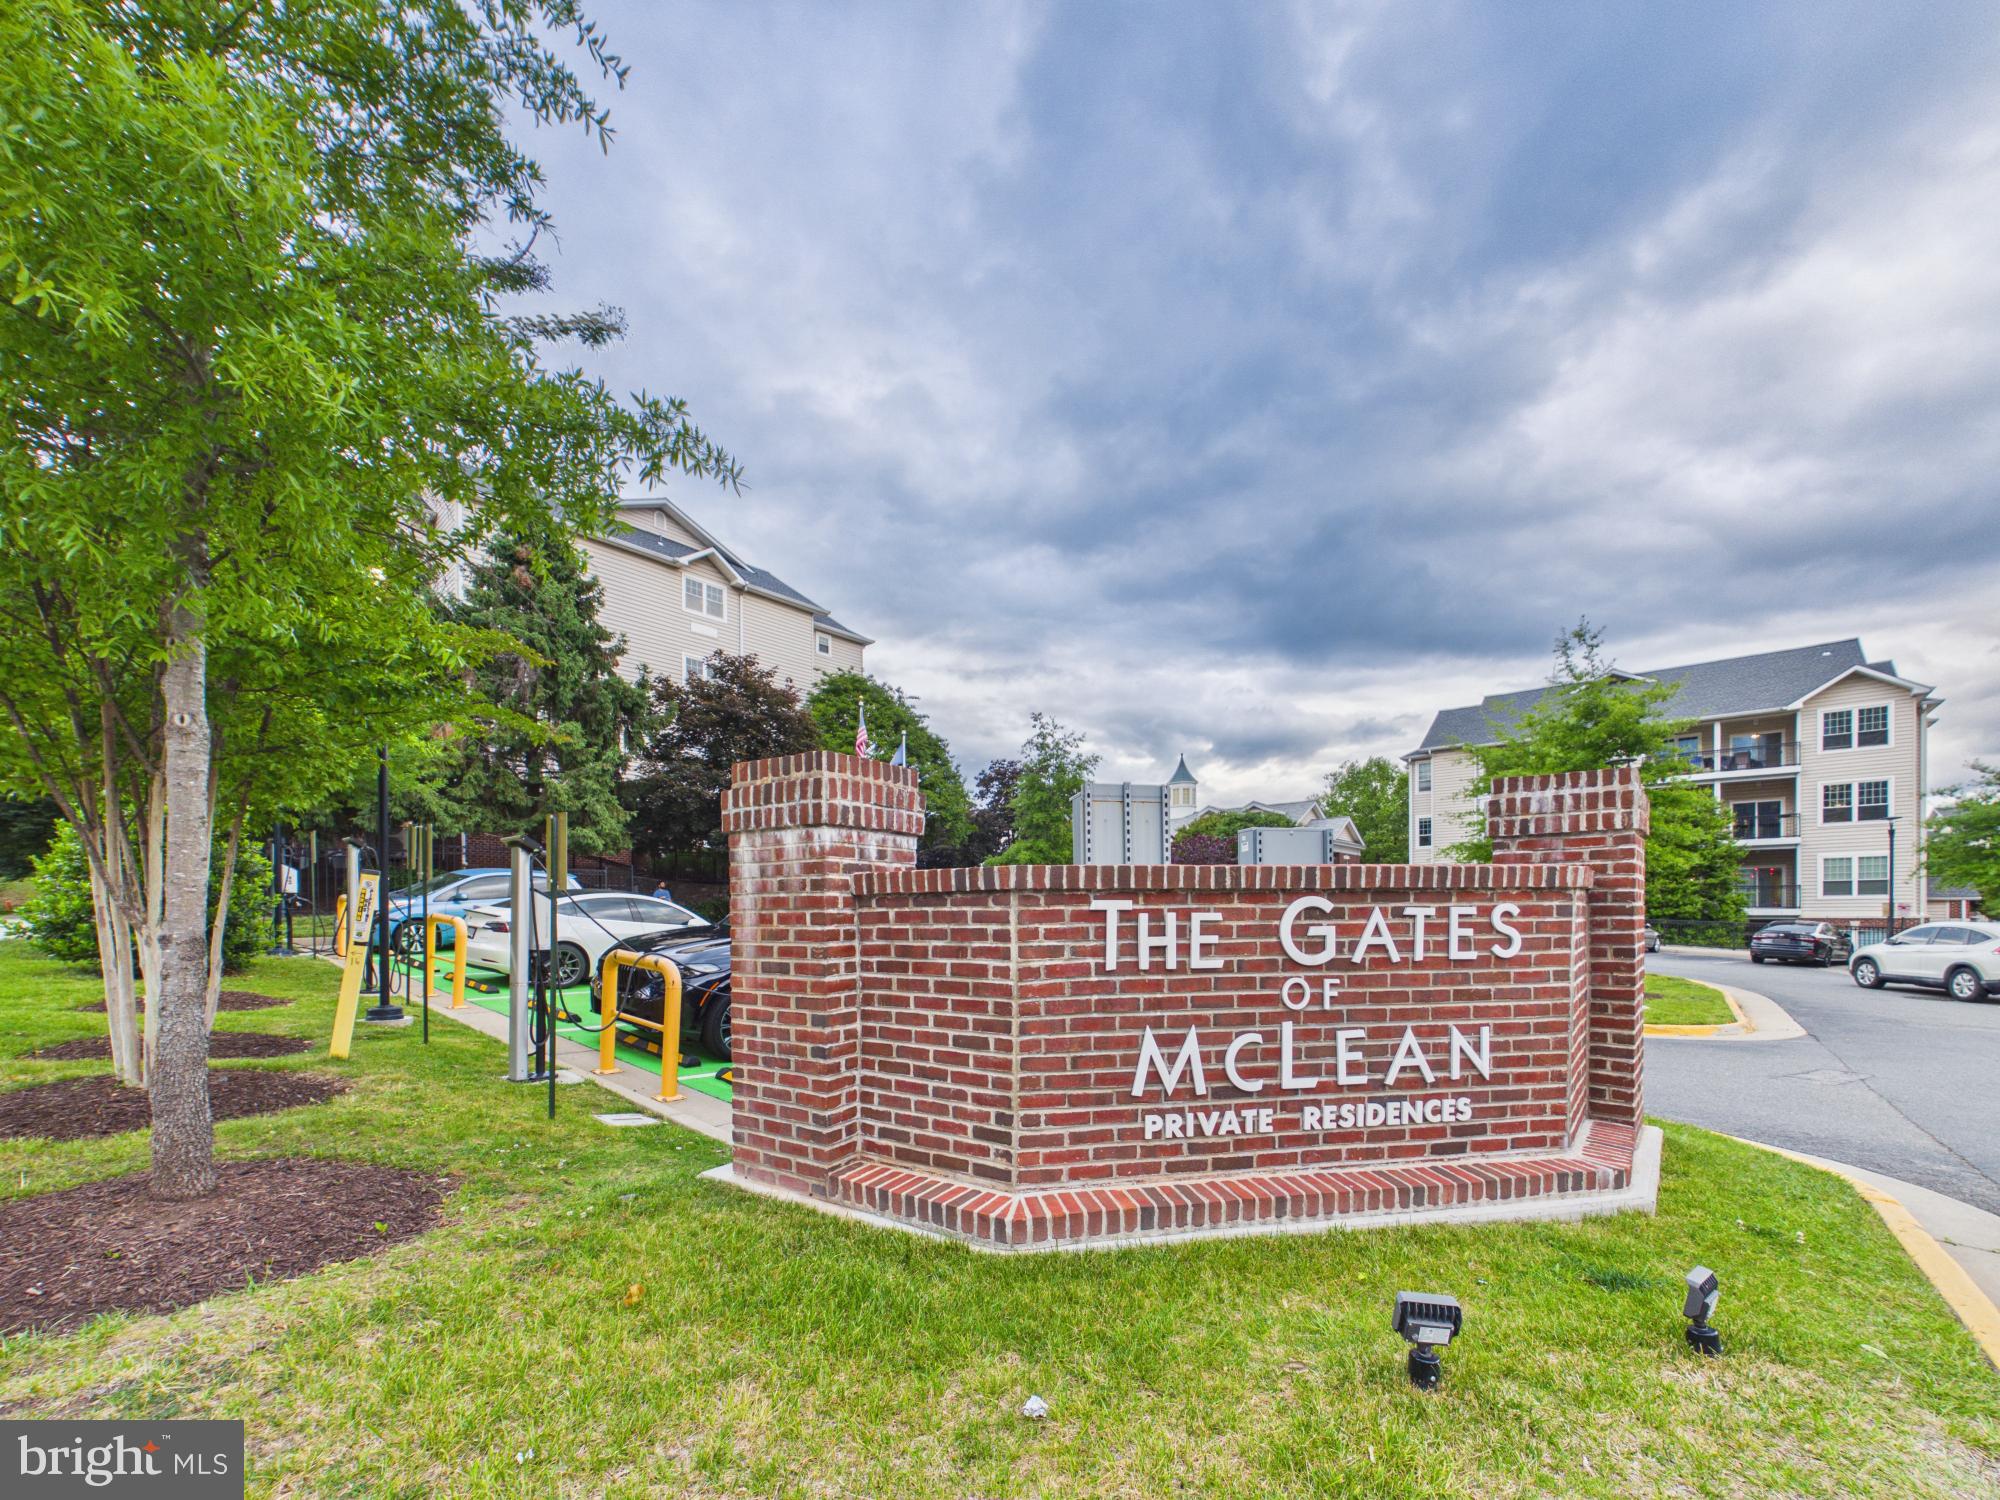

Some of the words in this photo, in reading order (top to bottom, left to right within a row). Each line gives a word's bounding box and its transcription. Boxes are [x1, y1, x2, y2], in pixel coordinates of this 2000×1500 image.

[1090, 899, 1224, 971] THE
[1279, 896, 1522, 966] GATES
[1281, 977, 1340, 1010] OF
[1144, 1108, 1274, 1140] PRIVATE
[1303, 1097, 1472, 1131] RESIDENCES
